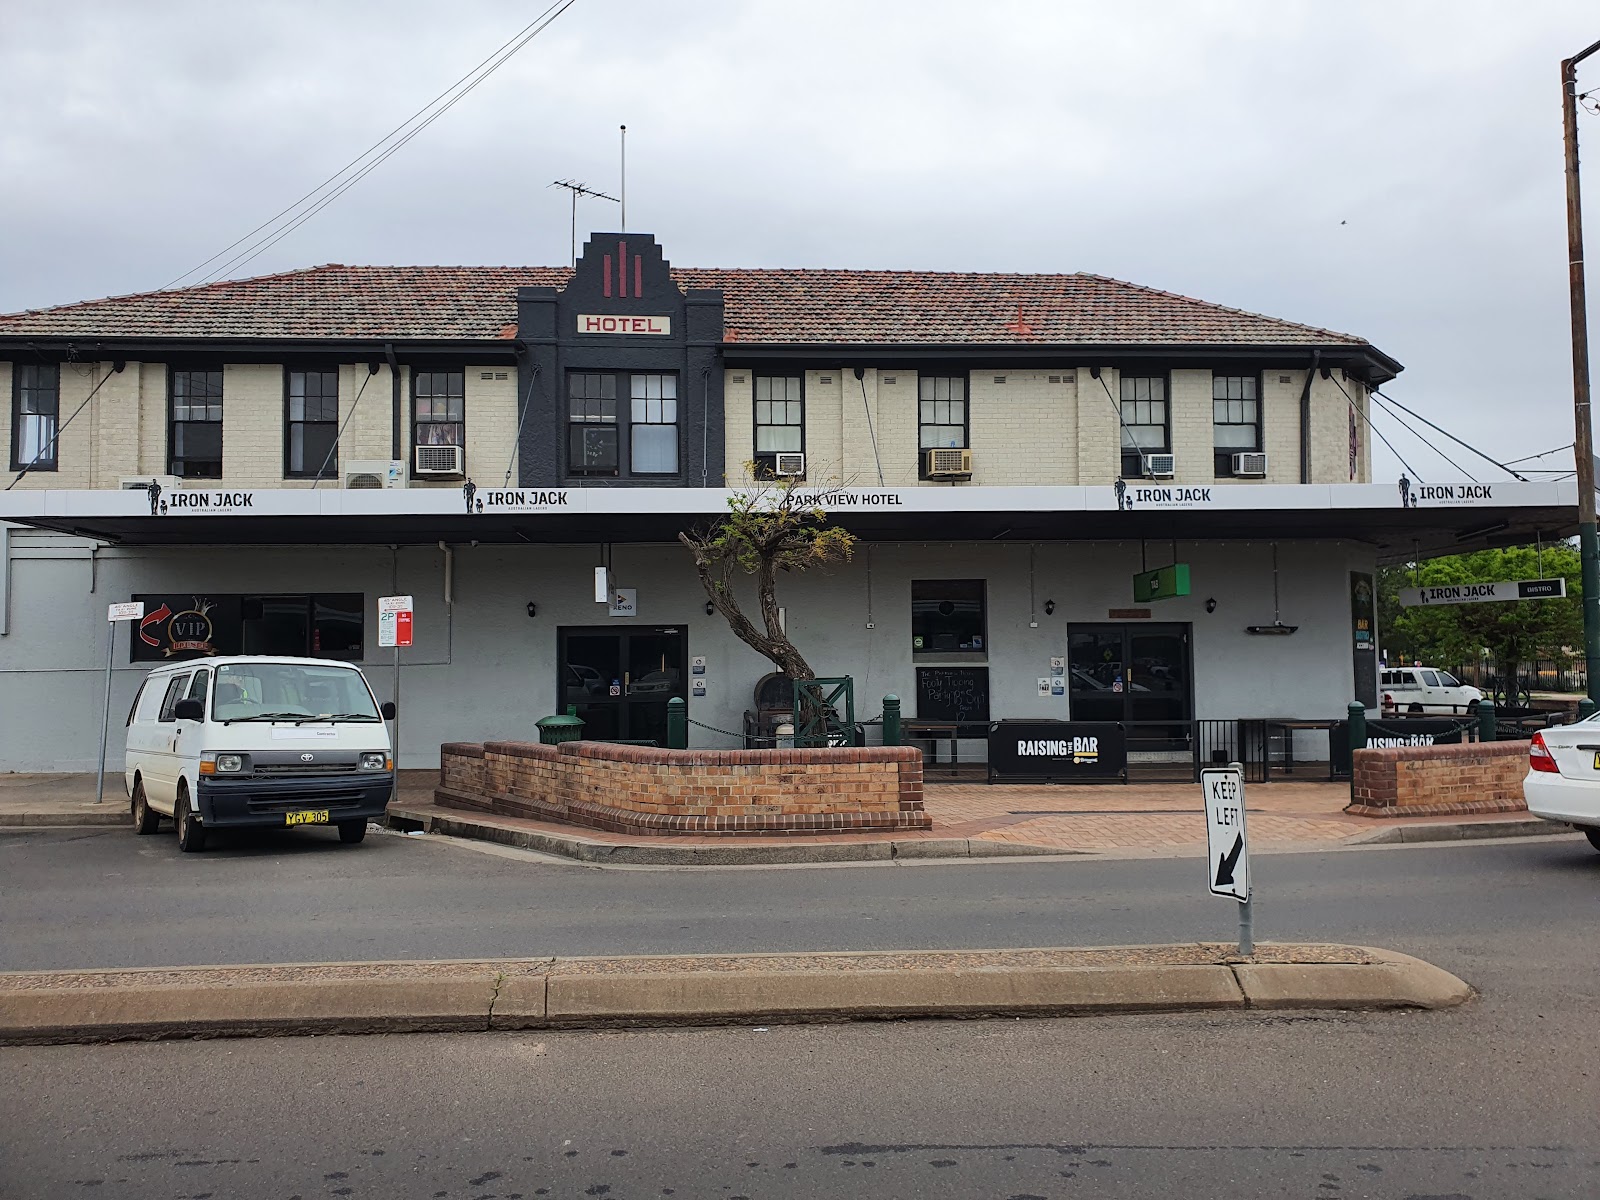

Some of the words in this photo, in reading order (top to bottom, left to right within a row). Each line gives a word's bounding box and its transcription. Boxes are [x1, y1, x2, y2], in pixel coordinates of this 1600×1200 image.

[586, 317, 662, 333] HOTEL
[487, 491, 525, 505] IRON
[529, 491, 568, 505] JACK
[1135, 489, 1172, 502] IRON
[1175, 488, 1211, 502] JACK
[1419, 486, 1454, 499] IRON
[1457, 485, 1493, 499] JACK
[170, 493, 210, 507] IRON
[213, 493, 253, 507] JACK
[786, 494, 822, 506] PARK
[825, 494, 859, 505] VIEW
[862, 494, 903, 505] HOTEL
[1429, 587, 1460, 599] IRON
[1463, 584, 1496, 597] JACK
[381, 613, 394, 621] 2P
[175, 622, 206, 636] VIP
[1357, 619, 1369, 630] BAR
[1017, 740, 1067, 756] RAISING
[1073, 736, 1098, 752] BAR
[1366, 737, 1405, 749] AISING
[1212, 781, 1237, 800] KEEP
[288, 813, 308, 825] YGV
[311, 812, 327, 823] 305
[1215, 806, 1239, 827] LEFT
